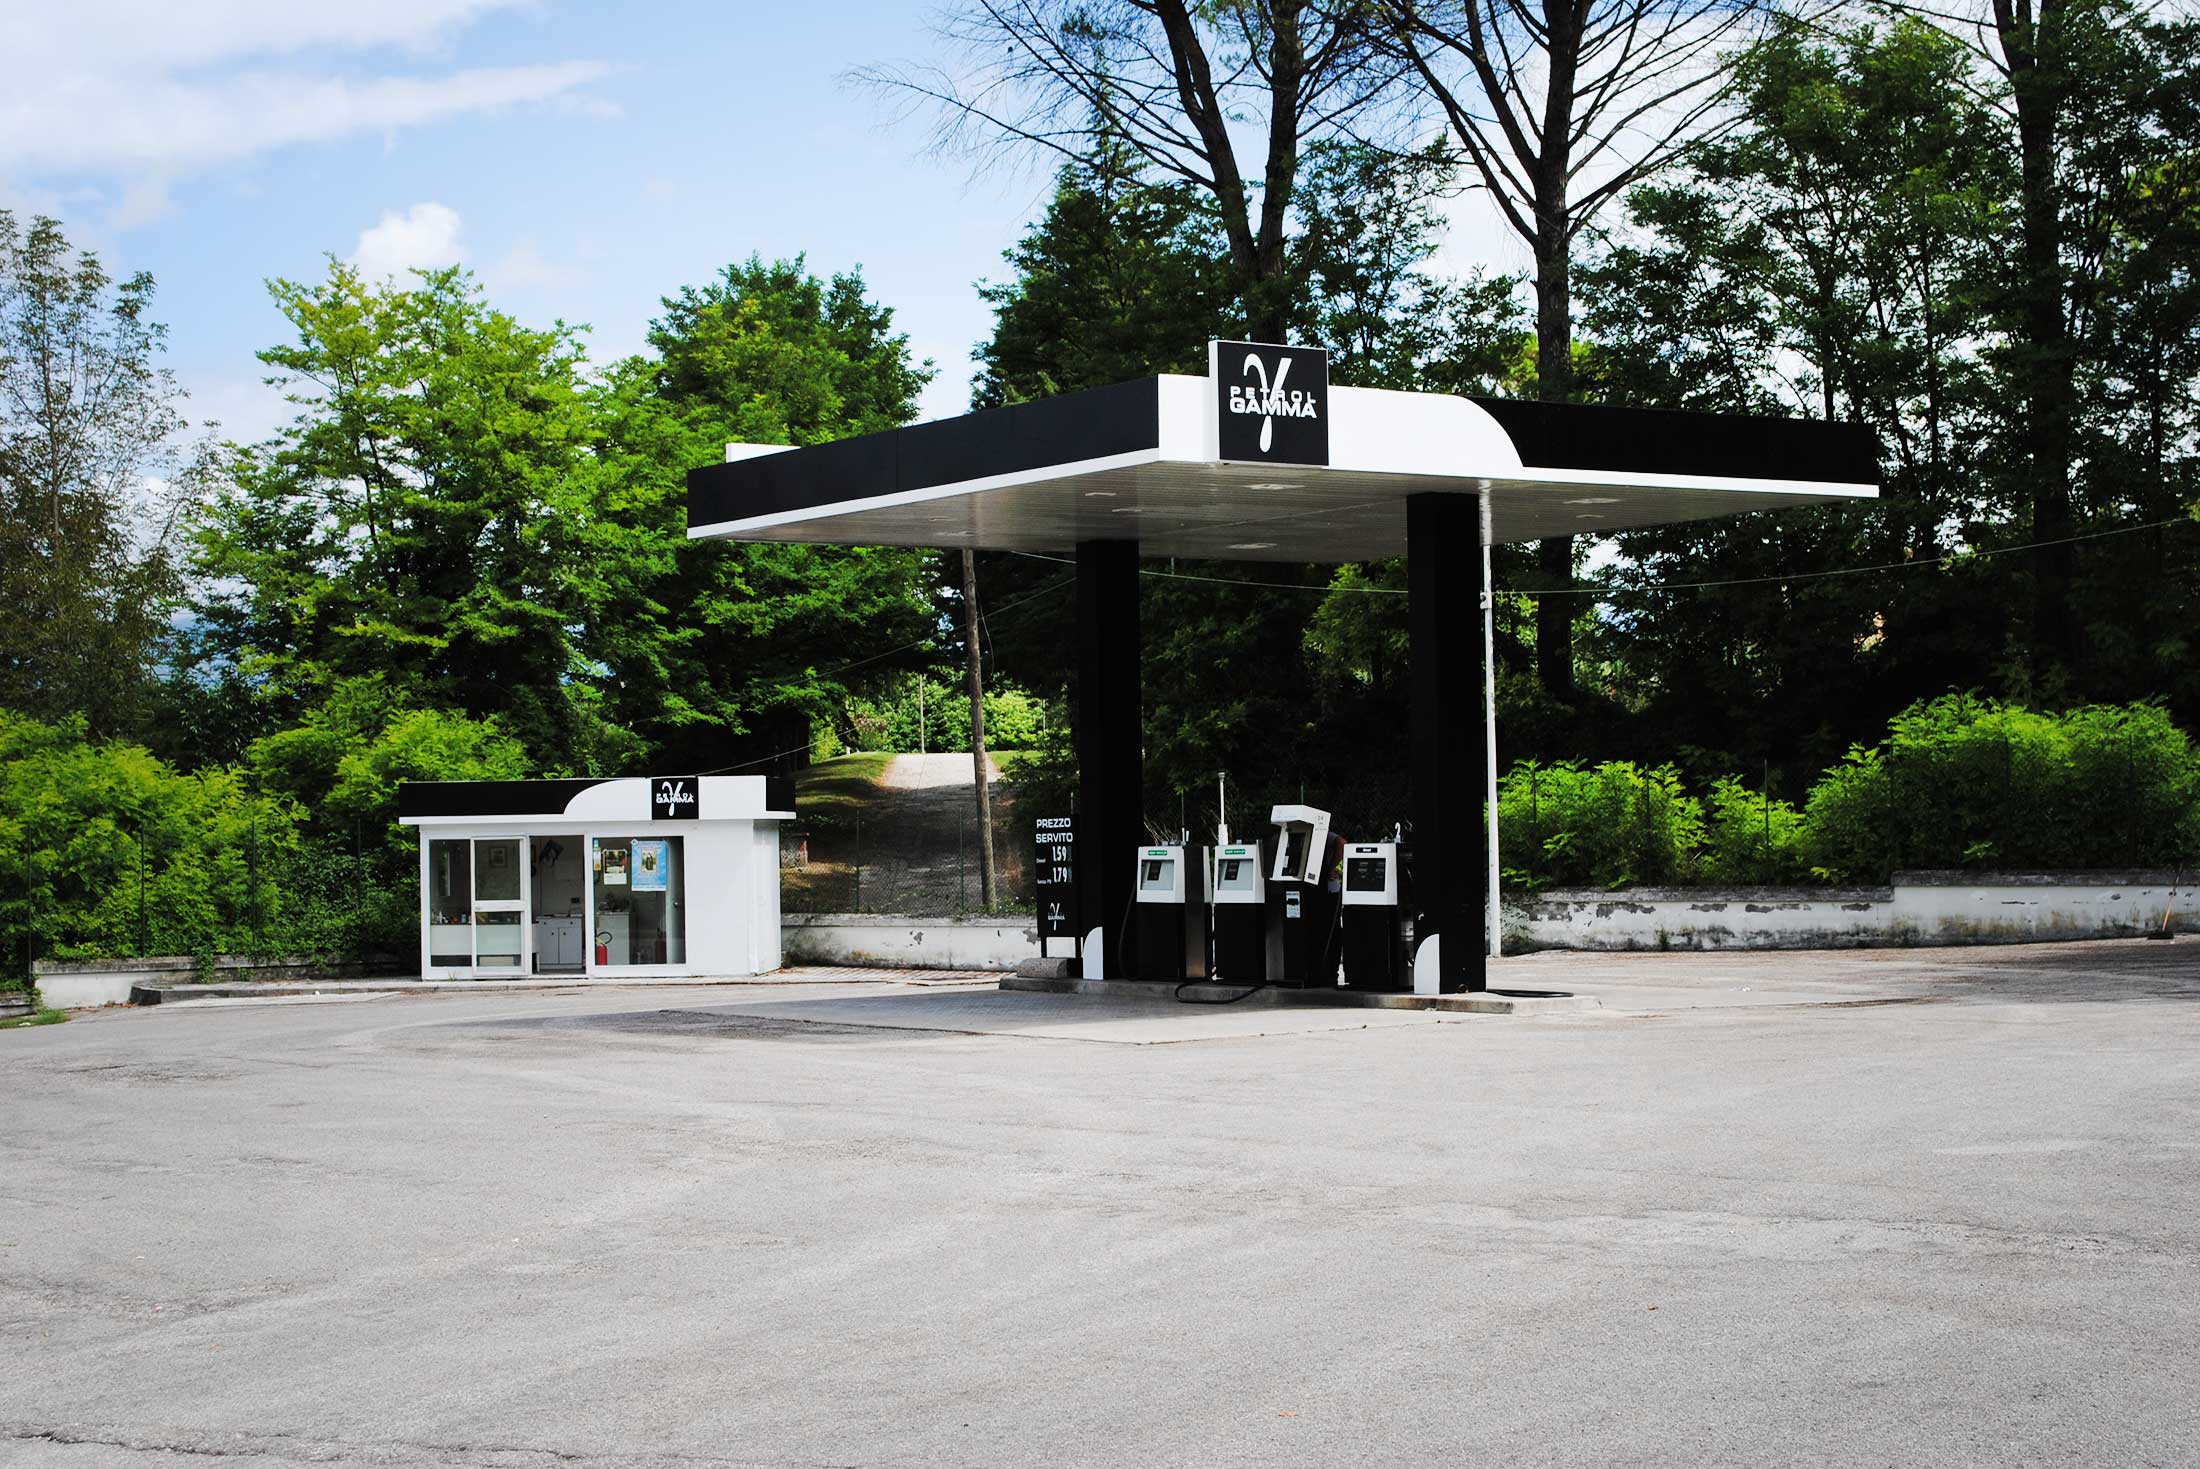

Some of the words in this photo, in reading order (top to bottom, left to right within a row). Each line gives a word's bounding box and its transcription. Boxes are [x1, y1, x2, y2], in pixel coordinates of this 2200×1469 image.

[1230, 385, 1316, 404] PETROL
[1229, 397, 1317, 418] GAMMA
[1036, 818, 1071, 829] PREZZO
[1035, 832, 1073, 843] SERVITO
